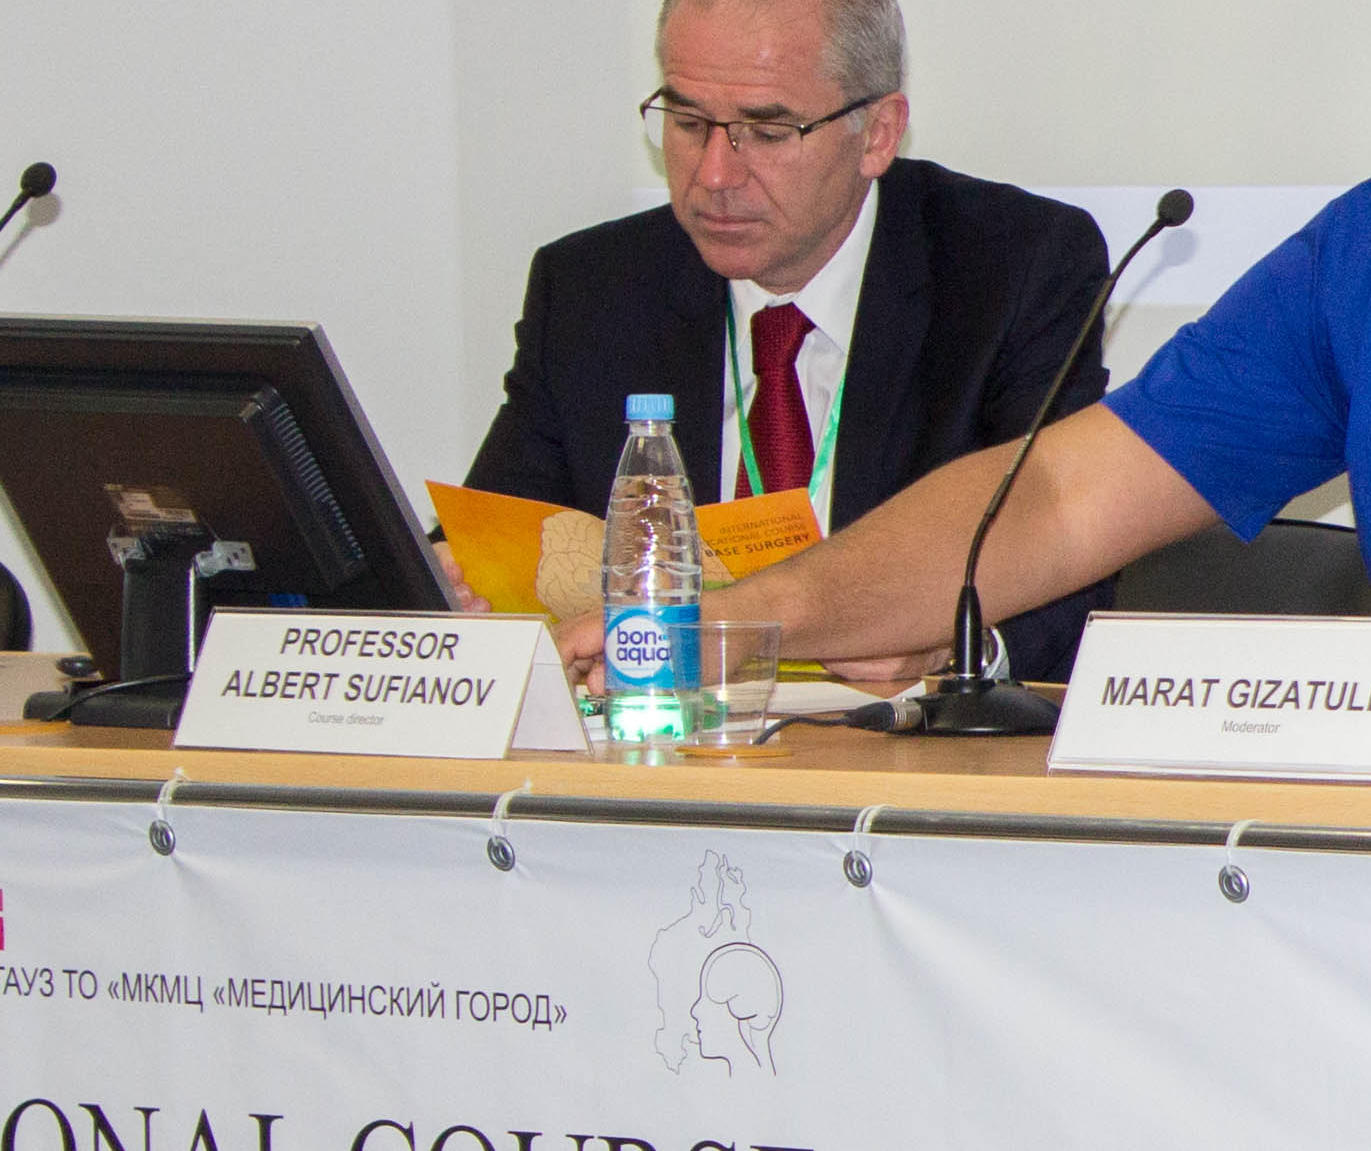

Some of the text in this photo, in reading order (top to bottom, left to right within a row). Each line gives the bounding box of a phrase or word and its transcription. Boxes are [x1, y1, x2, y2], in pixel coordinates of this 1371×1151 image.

[704, 532, 809, 558] BASE SURGERY
[280, 628, 459, 660] PROFESSOR
[616, 647, 671, 666] aqua
[220, 670, 496, 707] ALBERT SUFIANOV
[1101, 677, 1220, 707] MARAT
[307, 711, 345, 725] Course
[1220, 719, 1281, 734] Moderator
[0, 966, 568, 1031] АУЗ ТО «МКМЦ «МЕДИЦИНСКИЙ ГОРОД»
